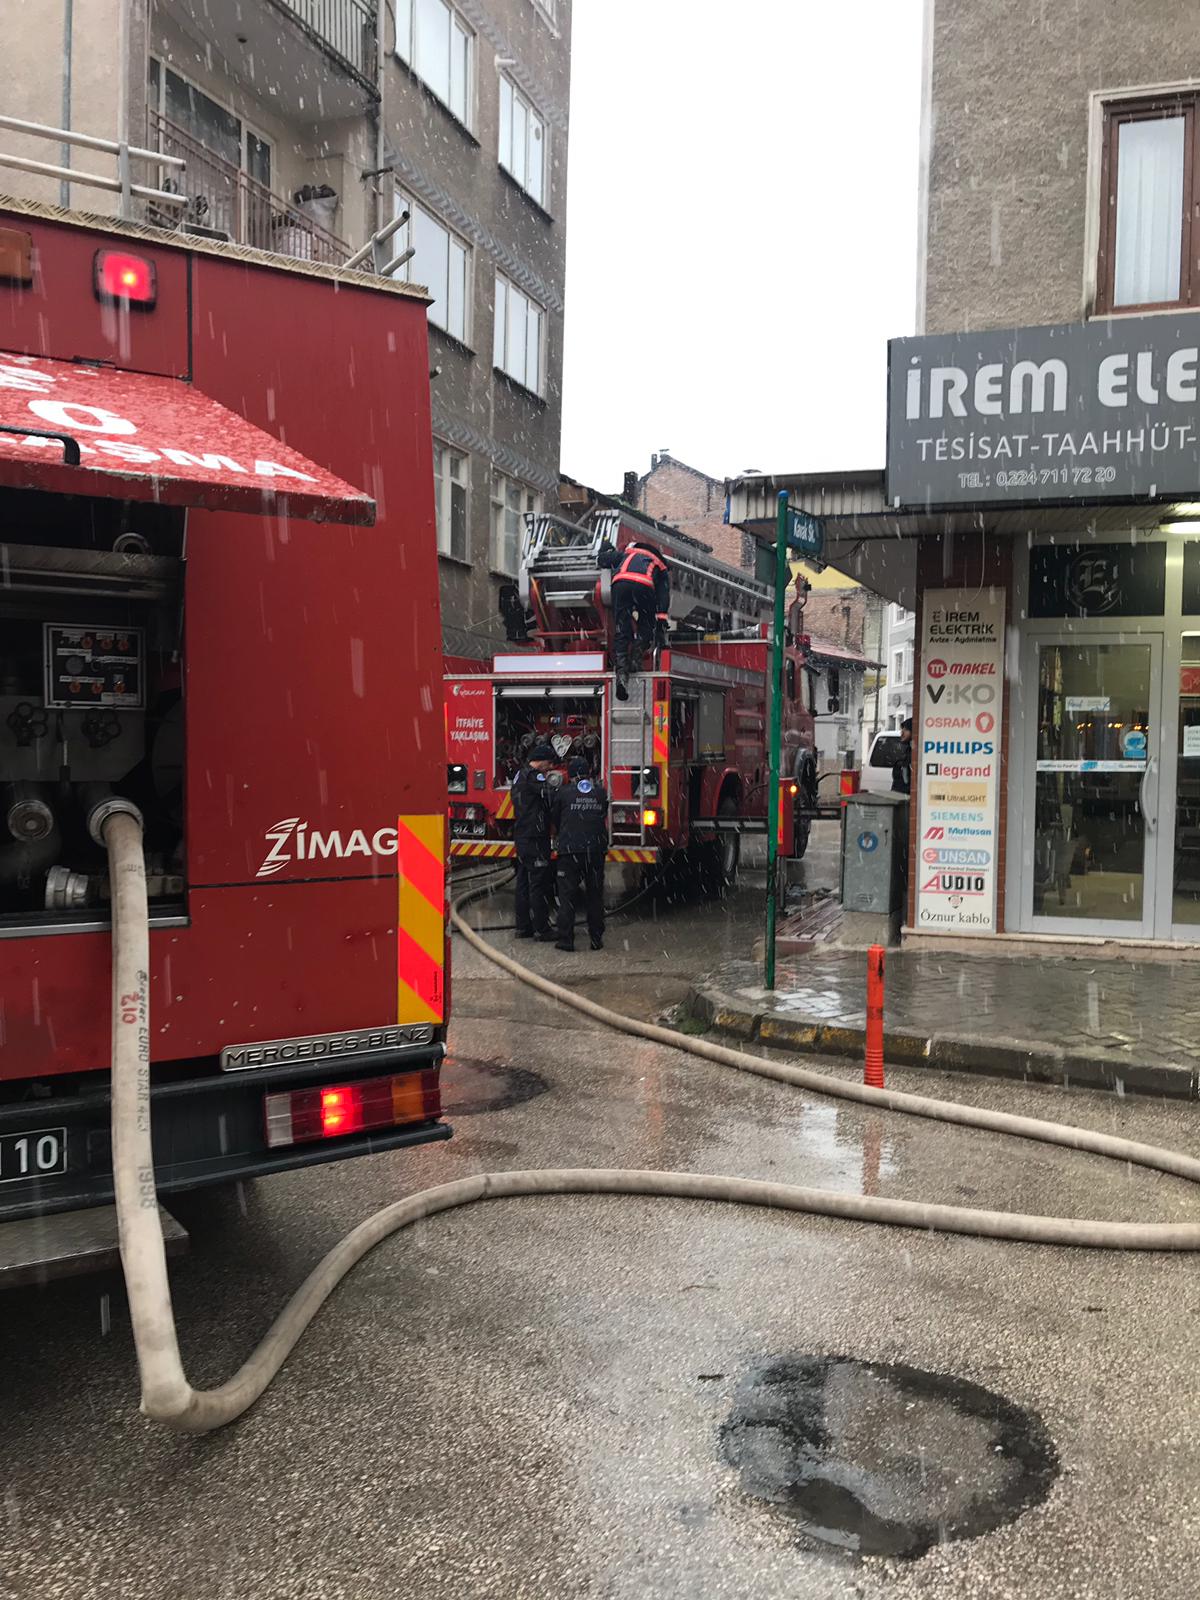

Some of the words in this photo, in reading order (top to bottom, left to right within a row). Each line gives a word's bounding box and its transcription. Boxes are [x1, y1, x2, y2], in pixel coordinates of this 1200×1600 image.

[906, 356, 1068, 420] İREM
[1098, 347, 1199, 407] ELE
[996, 469, 1038, 487] 0224
[1040, 468, 1069, 485] 711
[1072, 467, 1092, 484] 72
[1095, 466, 1117, 483] 20
[929, 622, 995, 635] ELEKTRİK
[949, 663, 996, 675] MAKEL
[456, 716, 485, 728] İTFAİYE
[925, 717, 971, 729] OSRAM
[450, 730, 490, 742] YAKLAŞMA
[924, 741, 994, 755] PHILIPS
[939, 763, 991, 779] legrand
[930, 812, 984, 822] SIEMENS
[922, 874, 985, 892] AUDIO
[920, 908, 956, 923] Öznur
[958, 911, 991, 925] kablo
[225, 1026, 430, 1067] MERCEDES-BENZ
[0, 1135, 59, 1174] 10
